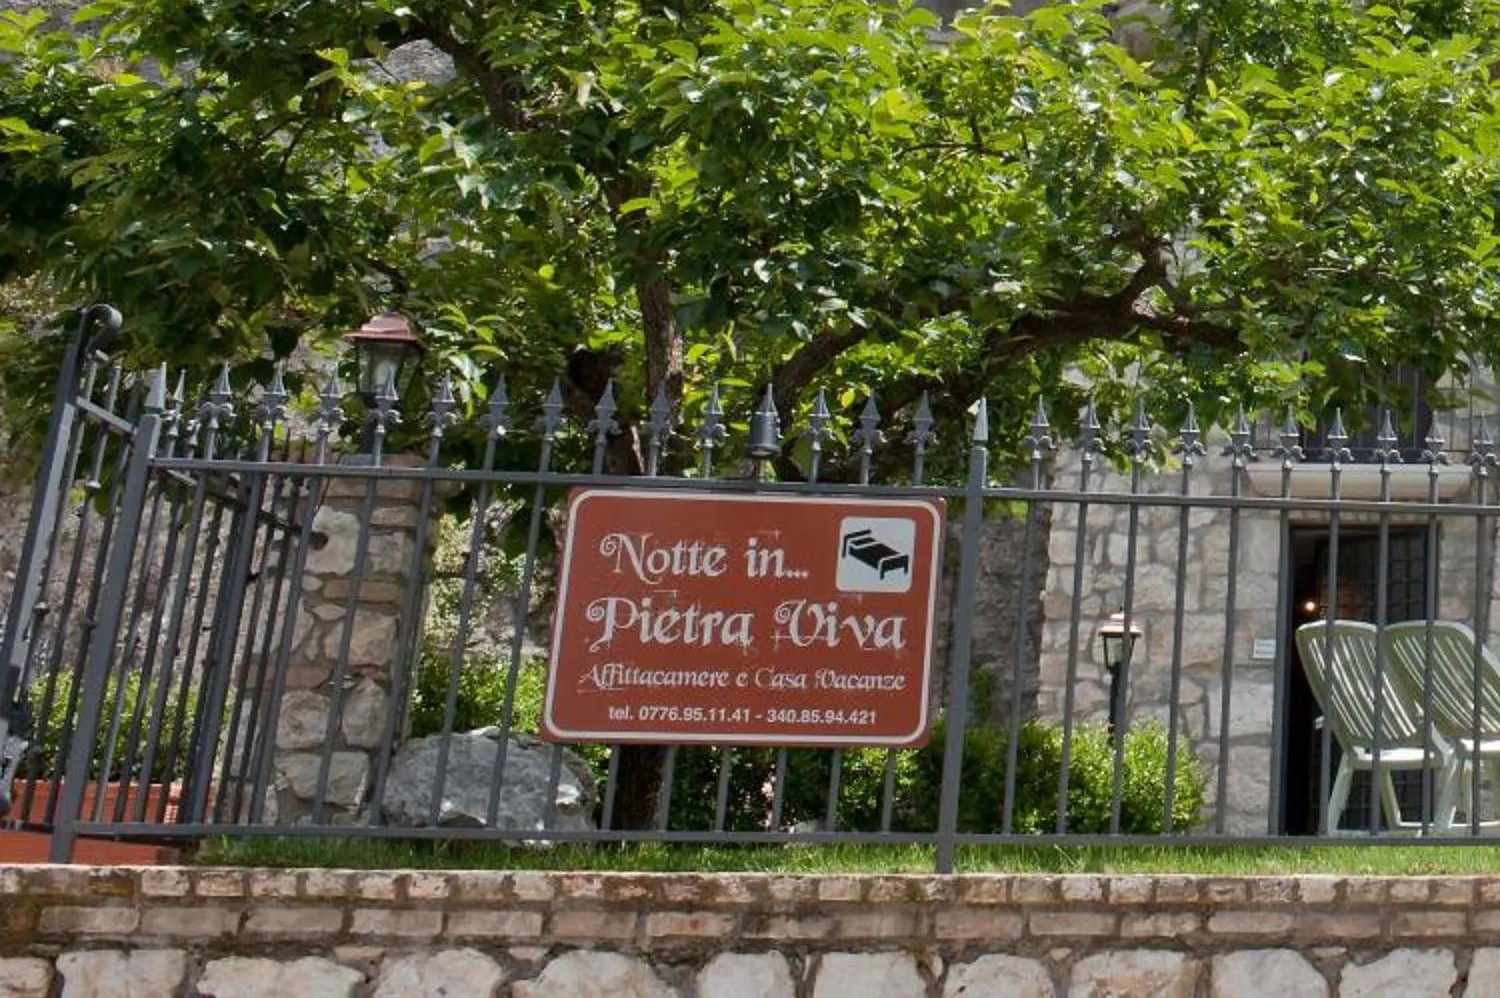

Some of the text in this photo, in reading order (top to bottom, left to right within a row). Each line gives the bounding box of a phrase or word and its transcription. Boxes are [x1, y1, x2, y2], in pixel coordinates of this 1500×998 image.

[600, 533, 727, 585] Notte
[586, 597, 907, 654] Pietra Viva
[579, 662, 906, 692] Affittacamere e Casa Vacanze
[609, 705, 633, 721] tel.
[638, 706, 750, 723] 0776.95.11.41
[767, 709, 876, 725] 340.85.94.421
